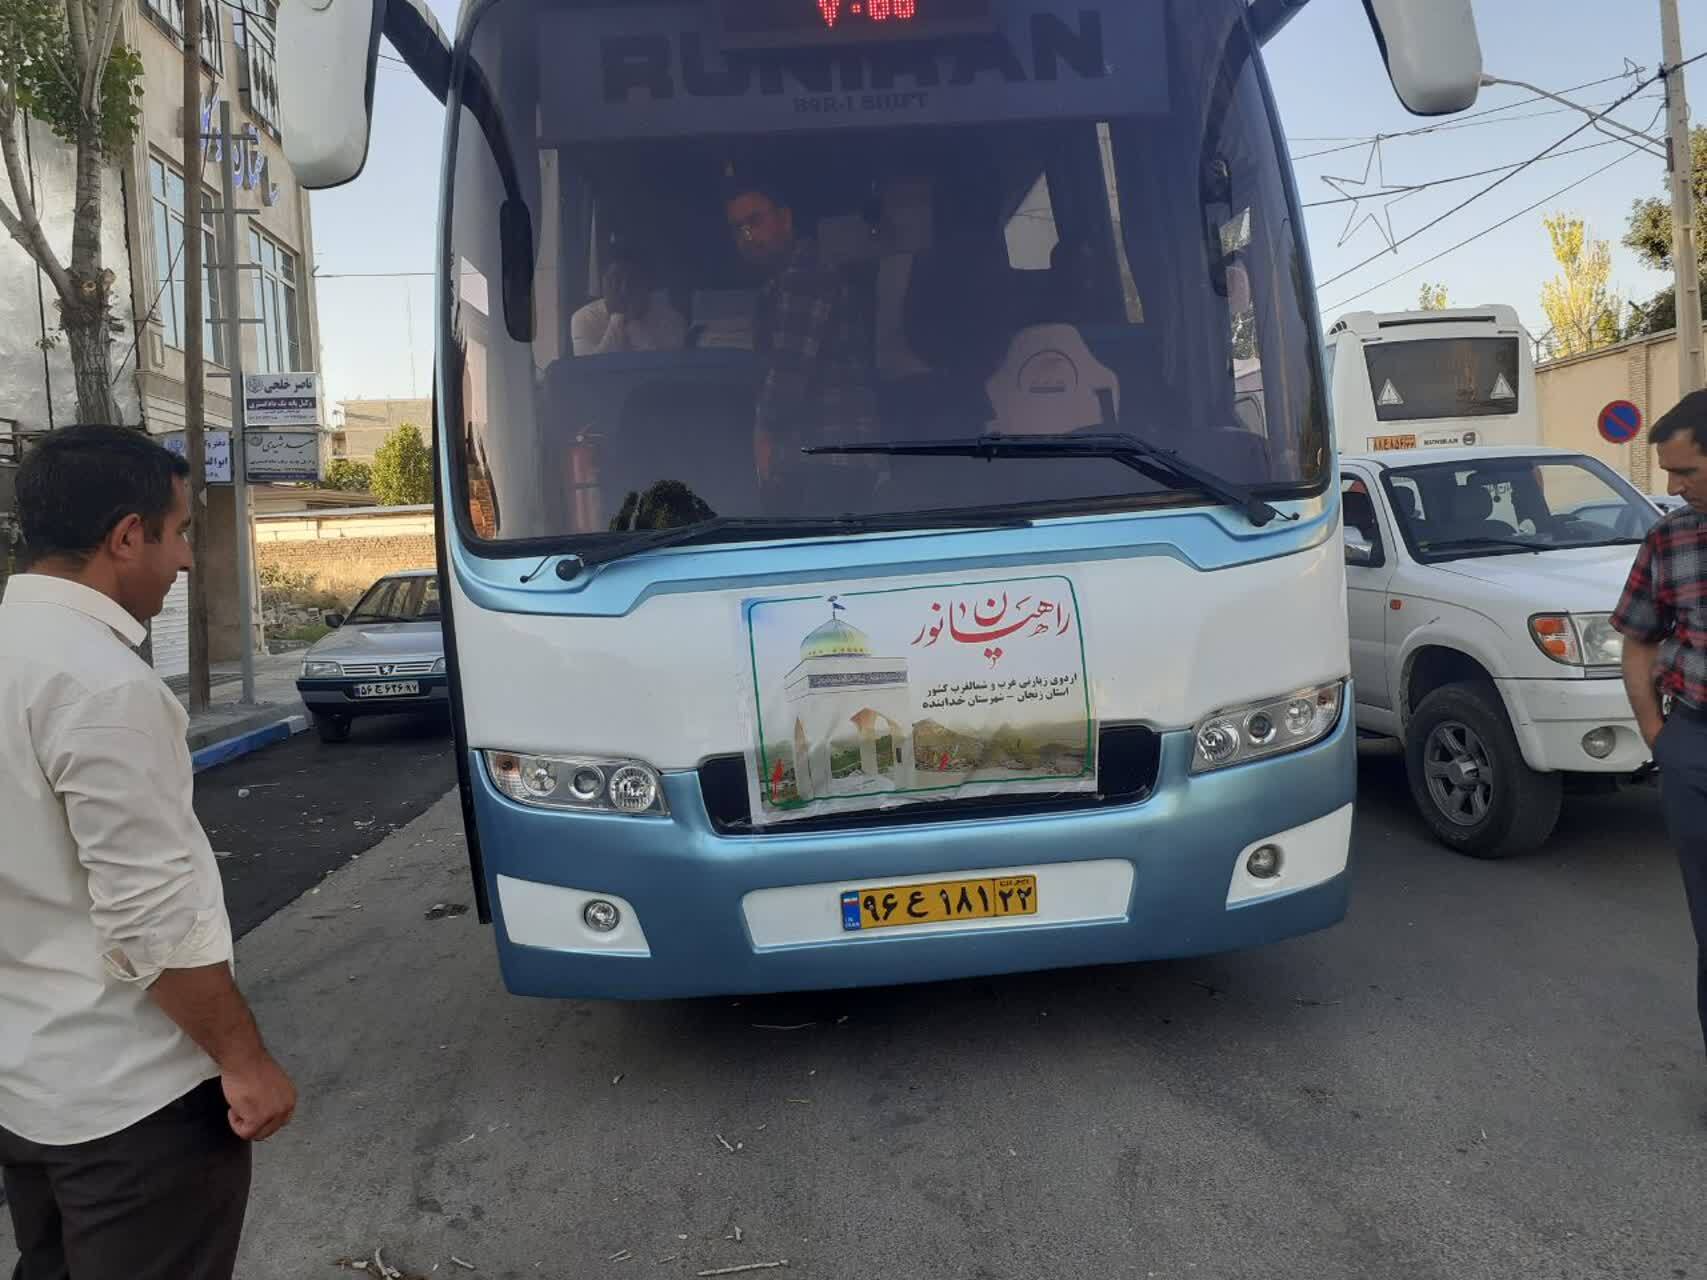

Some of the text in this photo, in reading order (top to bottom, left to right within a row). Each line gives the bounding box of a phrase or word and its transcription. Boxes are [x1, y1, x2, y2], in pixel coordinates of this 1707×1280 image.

[293, 377, 313, 393] ناصر
[910, 589, 1071, 669] راهیان نور
[998, 677, 1017, 689] غرب
[1019, 676, 1048, 690] زیارتی
[1049, 672, 1078, 686] اردوی
[927, 684, 948, 697] کشور
[1017, 689, 1044, 702] زنجان
[1046, 687, 1069, 700] استان
[922, 695, 965, 709] خدابنده
[967, 691, 1005, 707] شهرستان
[863, 885, 1032, 921] ۹۶ ع ۱۸۱ ۲۲
